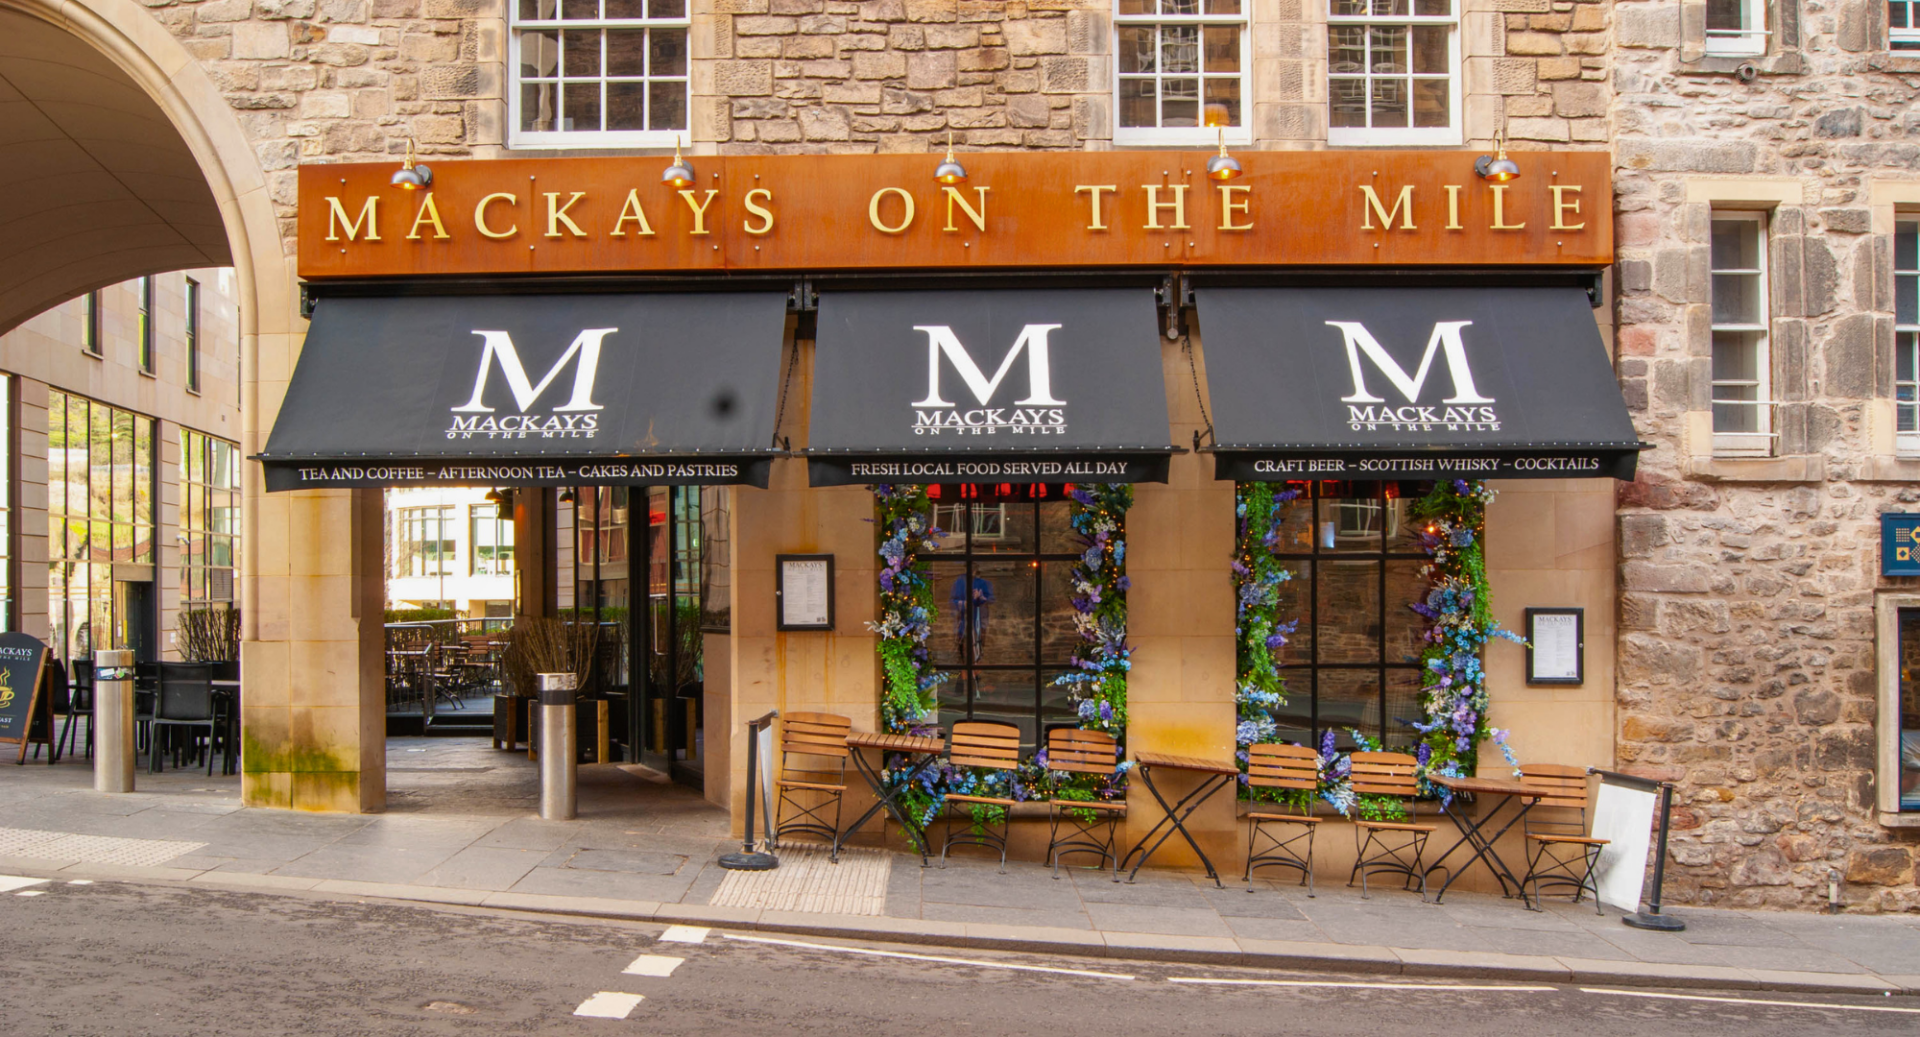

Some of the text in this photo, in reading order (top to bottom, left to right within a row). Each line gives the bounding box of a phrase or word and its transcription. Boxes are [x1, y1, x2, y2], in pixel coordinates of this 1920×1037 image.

[324, 184, 1586, 241] MACKAYS ON THE MILE
[451, 327, 619, 413] M
[911, 323, 1068, 408] M
[1325, 320, 1495, 404] M
[450, 413, 598, 430] MACKAYS
[915, 408, 1065, 426] MACKAYS
[1347, 405, 1497, 422] MACKAYS
[446, 430, 595, 439] ON THE MILE
[914, 426, 1065, 435] ON THE MILE
[1351, 422, 1500, 431] ON THE MILE
[298, 468, 329, 480] TEA
[331, 467, 364, 480] AND
[366, 467, 424, 480] COFFEE
[438, 466, 534, 479] AFTERNOON
[536, 466, 566, 479] TEA
[578, 465, 628, 478] CAKES
[630, 464, 664, 477] AND
[667, 464, 738, 477] PASTRIES
[851, 462, 1128, 475] FRESH LOCAL FOOD SERVED ALL DAY
[1254, 459, 1306, 472] CRAFT
[1308, 459, 1346, 471] BEER
[1359, 458, 1434, 471] SCOTTISH
[1437, 458, 1500, 470] WHISKY
[1514, 457, 1599, 470] COCKTAILS
